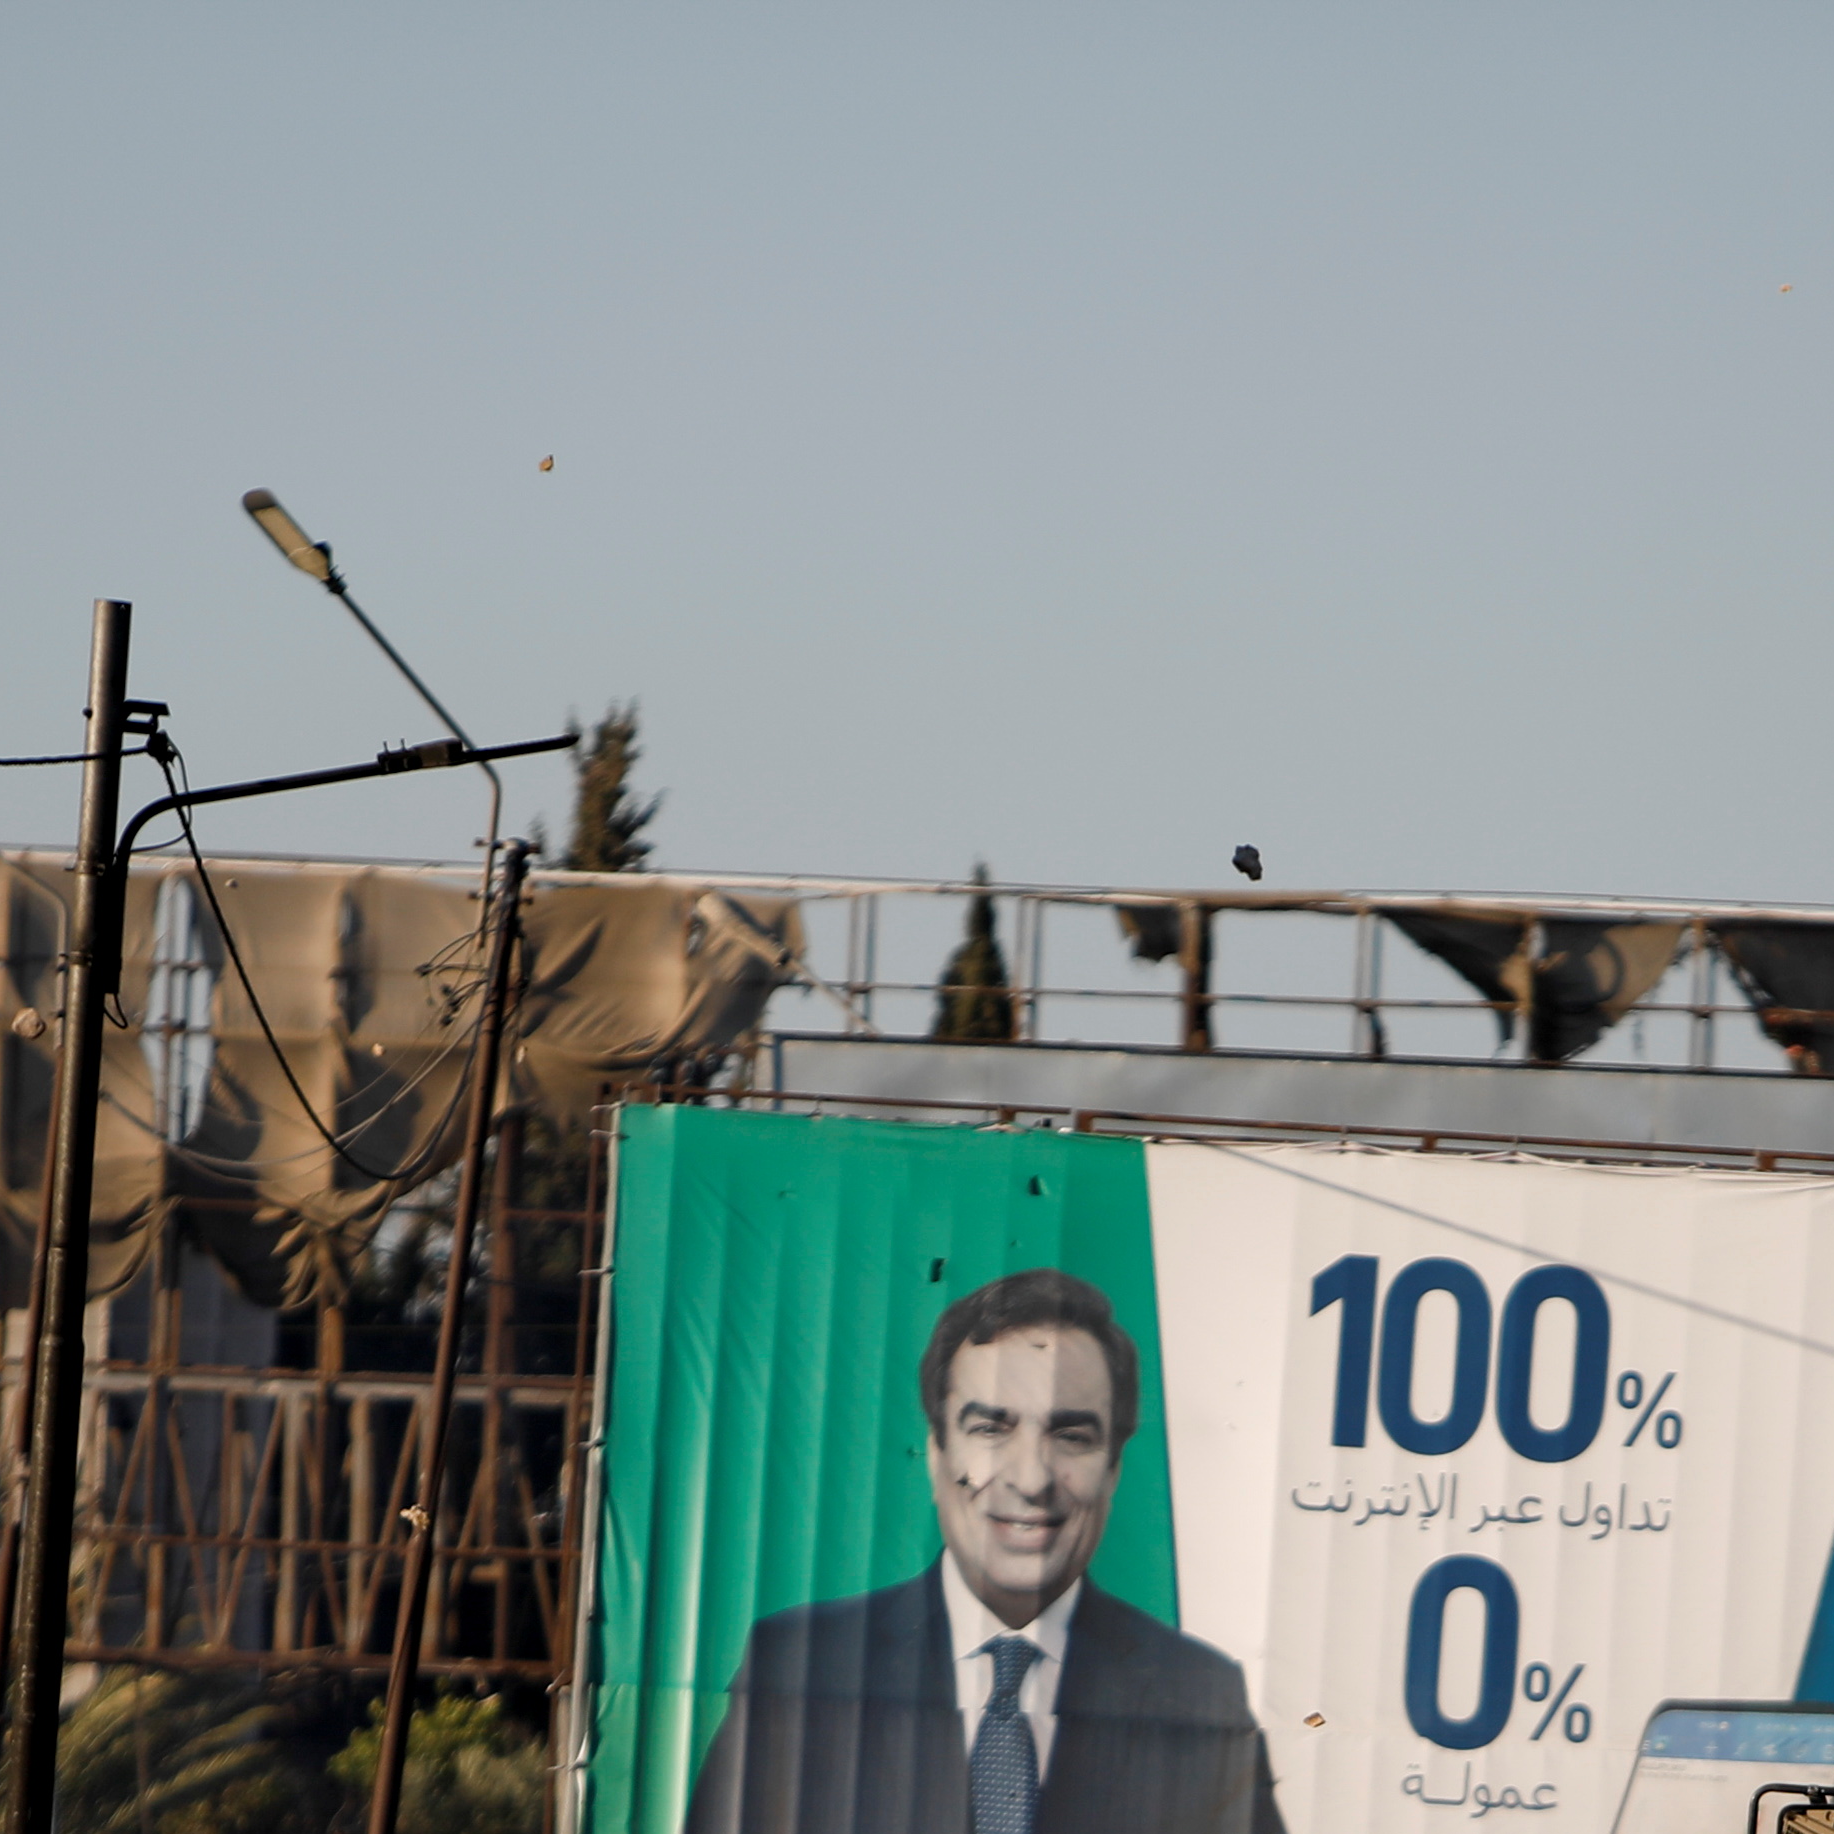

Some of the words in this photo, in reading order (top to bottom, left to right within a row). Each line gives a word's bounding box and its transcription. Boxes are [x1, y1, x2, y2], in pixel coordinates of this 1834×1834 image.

[1308, 1253, 1683, 1463] 100%
[1291, 1471, 1458, 1530] الإنترنت
[1469, 1495, 1543, 1532] عبر
[1559, 1481, 1672, 1540] تداول
[1403, 1553, 1592, 1750] 0%
